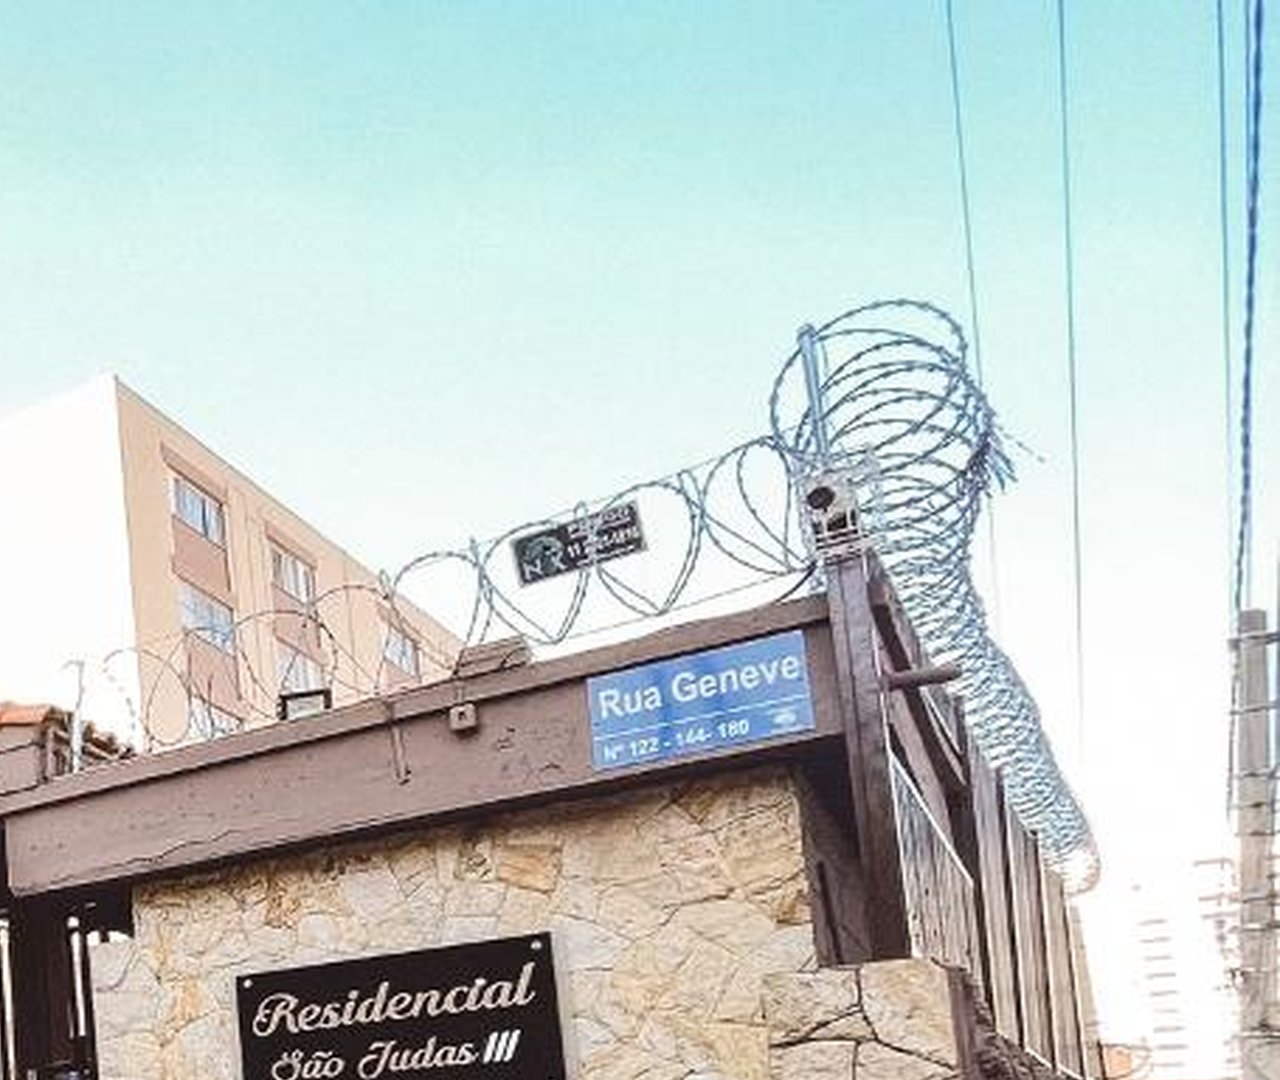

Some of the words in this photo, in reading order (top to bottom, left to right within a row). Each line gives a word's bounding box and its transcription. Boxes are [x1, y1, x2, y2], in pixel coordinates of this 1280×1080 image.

[598, 687, 663, 719] Rua
[671, 655, 800, 702] Geneve
[629, 736, 660, 757] 122
[717, 718, 750, 739] 180
[252, 961, 536, 1037] Residencial
[357, 1035, 480, 1080] Judas
